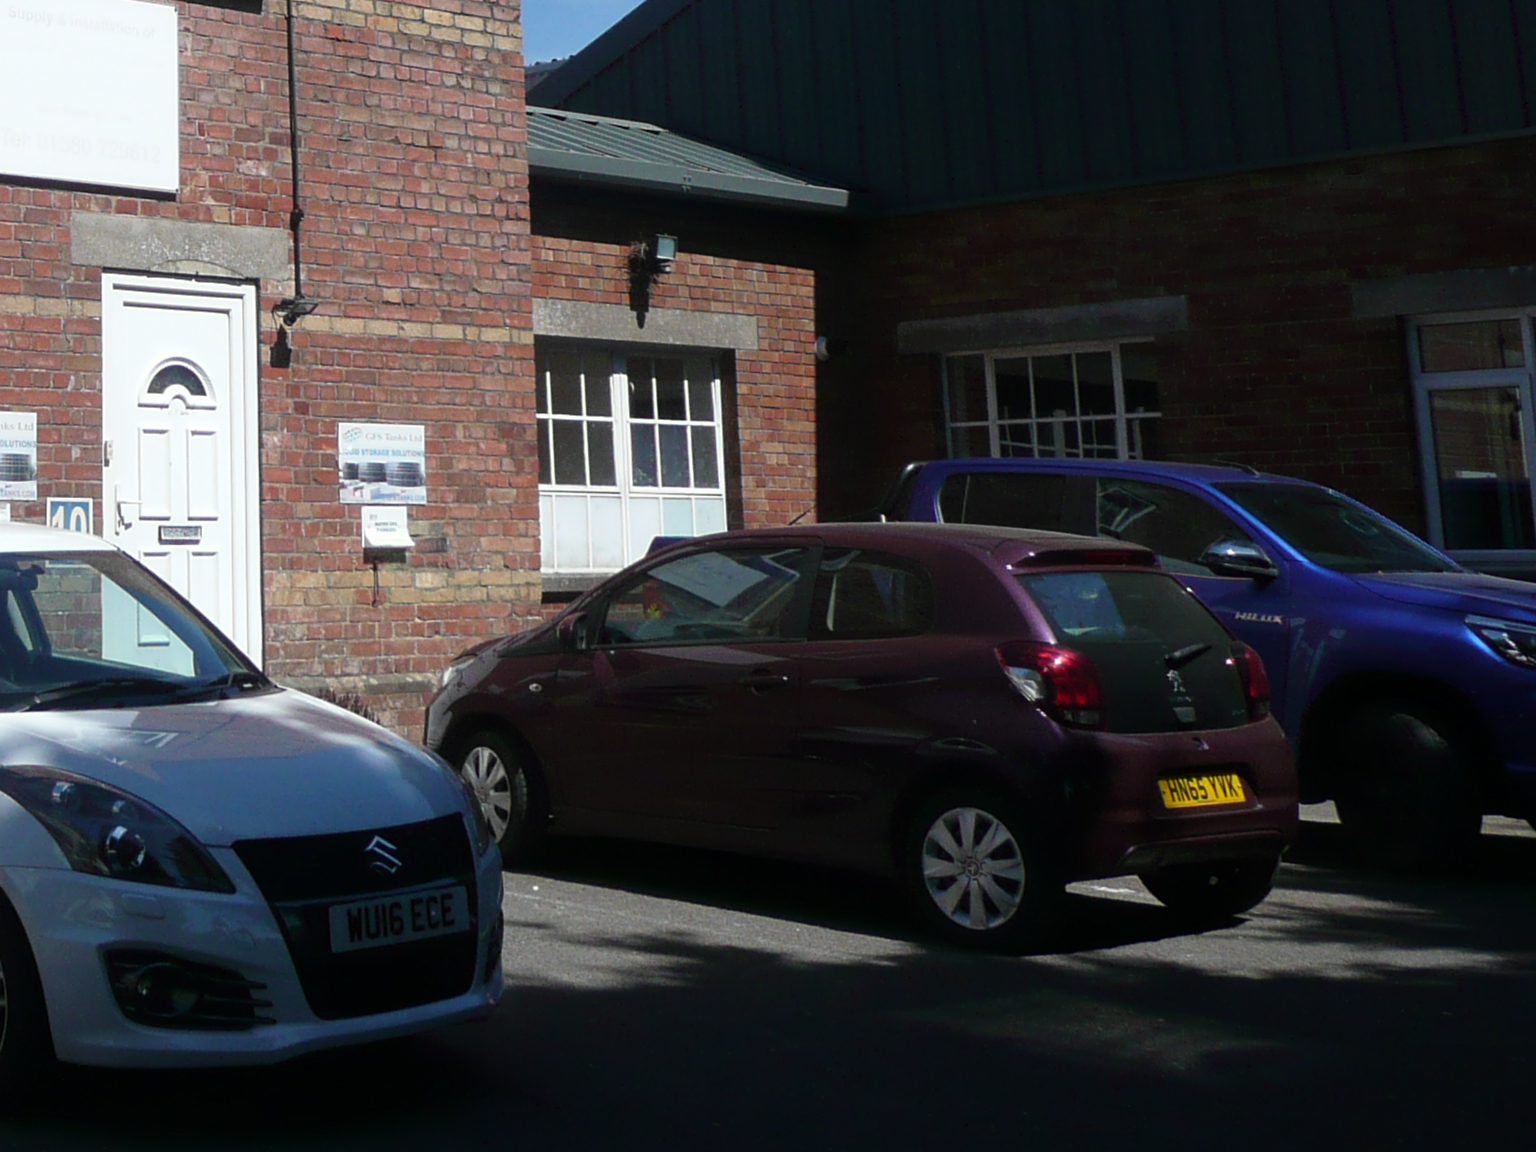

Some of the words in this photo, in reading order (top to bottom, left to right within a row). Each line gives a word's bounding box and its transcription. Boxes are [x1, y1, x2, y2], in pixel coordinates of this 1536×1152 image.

[7, 5, 53, 27] Supply
[56, 11, 67, 26] &
[142, 26, 156, 39] of
[1, 127, 31, 149] Tel:
[18, 422, 35, 431] Ltd
[52, 505, 88, 533] 10
[1235, 611, 1283, 625] HILUX
[1168, 776, 1209, 803] HN65
[1209, 773, 1240, 800] YVK
[346, 902, 405, 943] WU16
[410, 893, 456, 932] ECE
